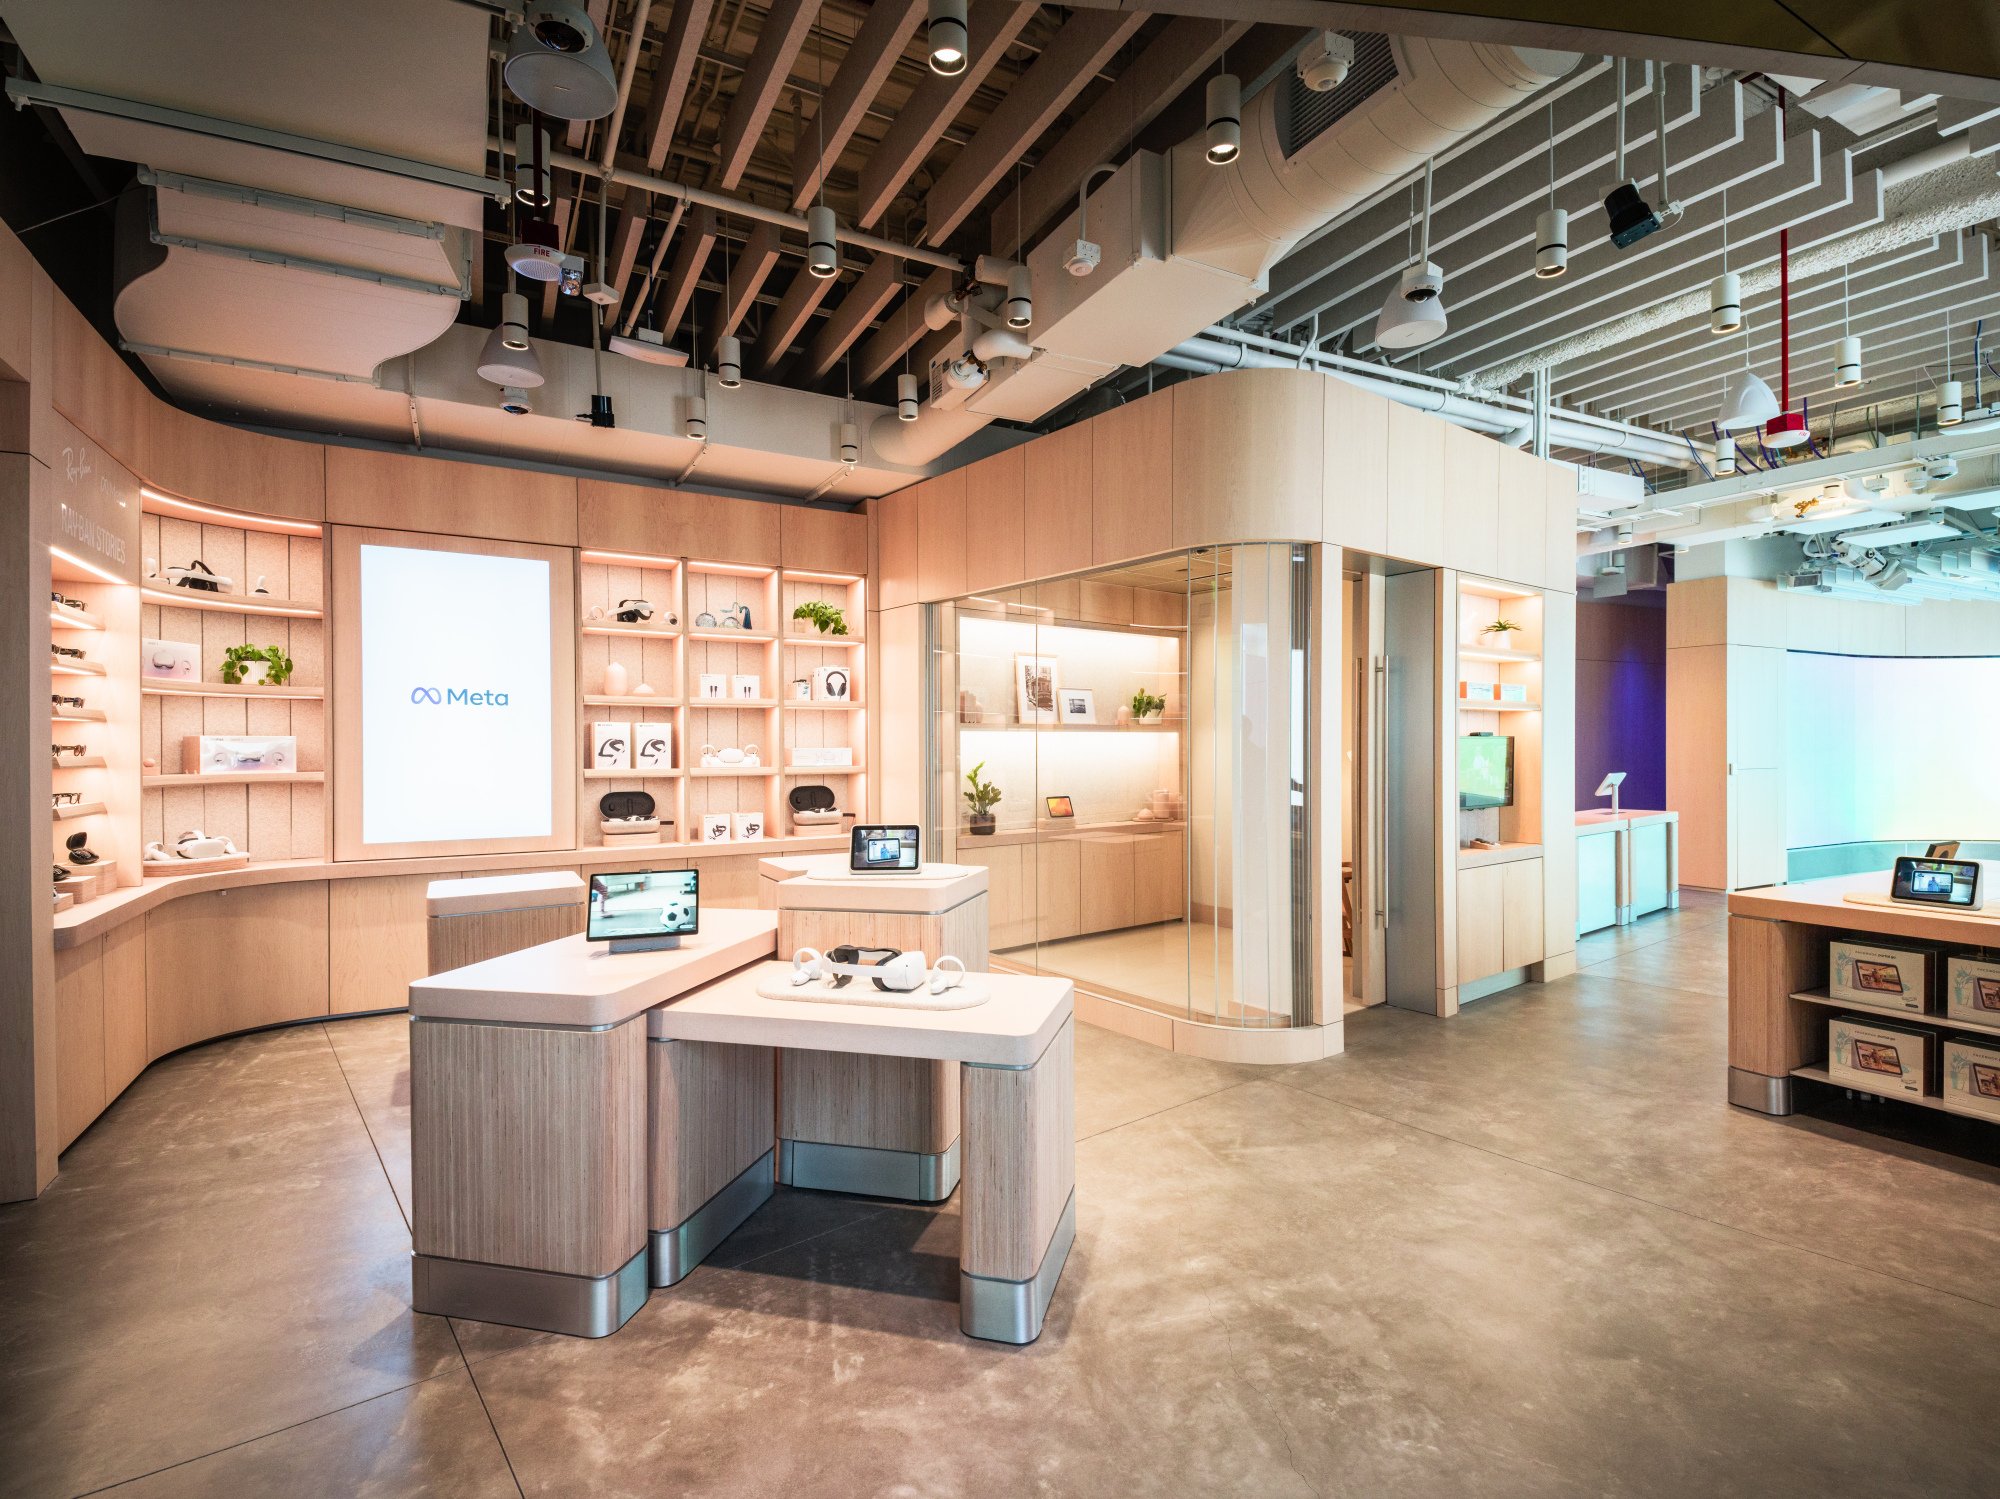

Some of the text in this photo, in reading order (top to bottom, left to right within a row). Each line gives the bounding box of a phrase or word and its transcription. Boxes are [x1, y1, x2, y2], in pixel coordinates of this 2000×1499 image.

[533, 247, 550, 257] FIRE
[96, 525, 126, 565] STORIES
[447, 687, 509, 706] Meta
